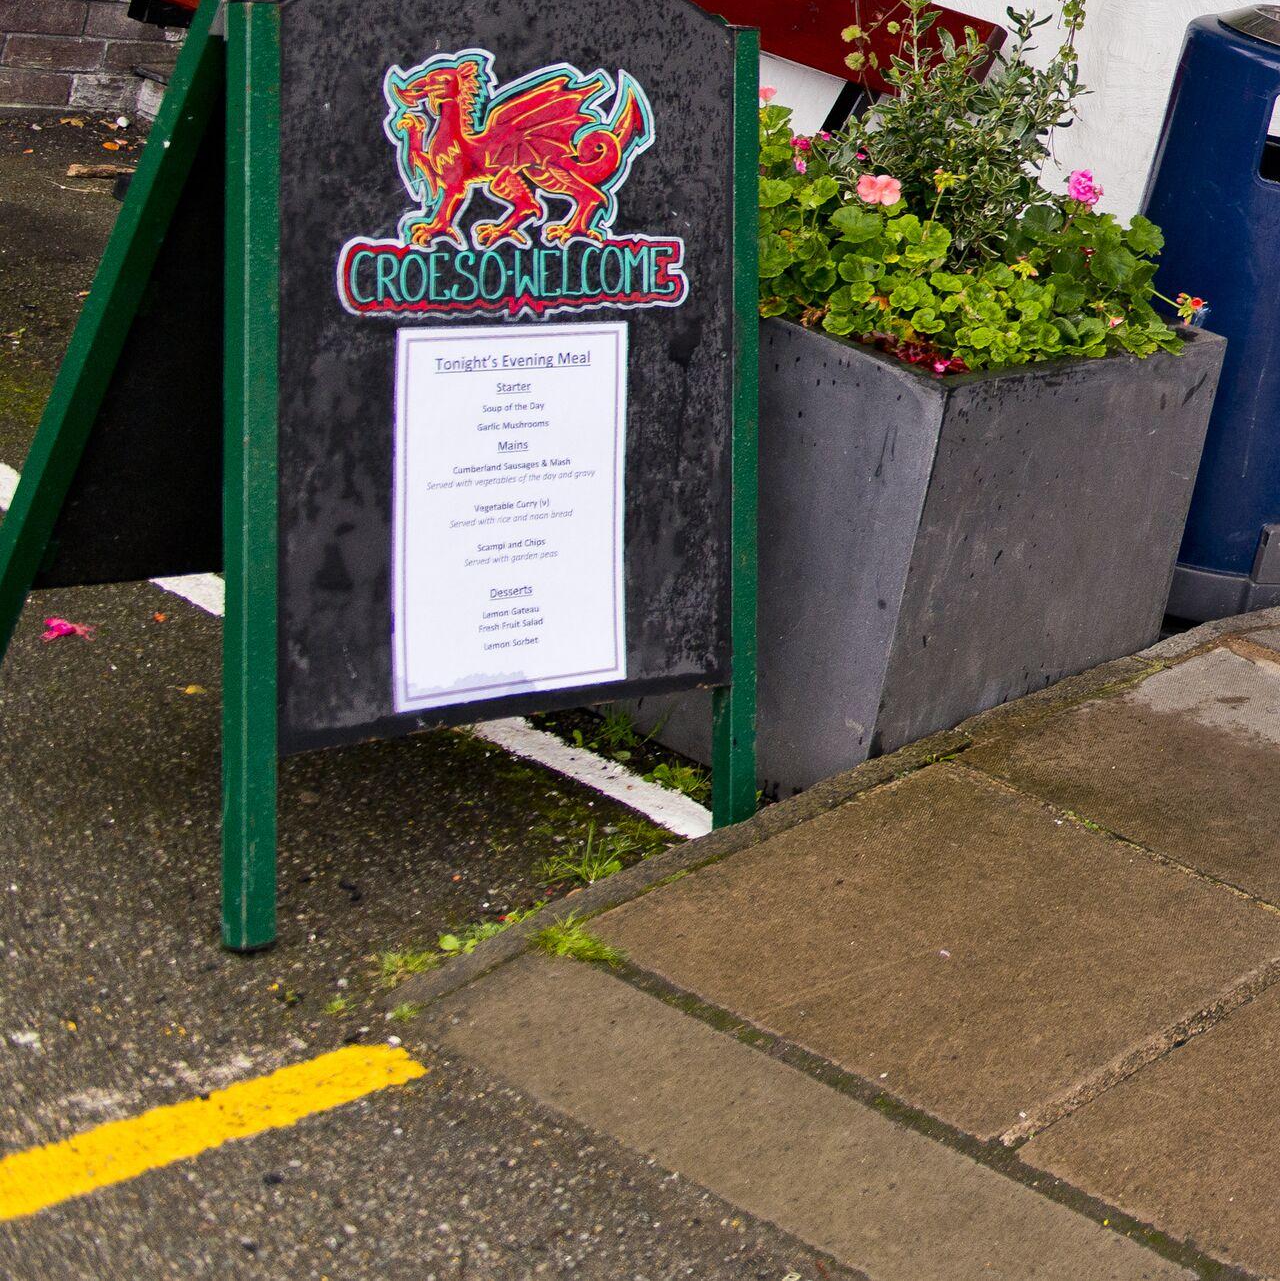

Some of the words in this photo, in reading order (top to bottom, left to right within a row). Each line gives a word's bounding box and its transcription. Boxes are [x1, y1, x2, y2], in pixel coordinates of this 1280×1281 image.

[435, 355, 498, 372] Tonight's
[502, 353, 554, 368] Evening
[558, 350, 591, 365] Meal
[496, 382, 532, 393] Starter
[482, 404, 502, 415] Soup
[504, 403, 513, 412] of
[514, 402, 528, 411] the
[530, 401, 545, 412] Day
[477, 422, 500, 432] Garlic
[502, 419, 550, 431] Mushrooms
[497, 440, 529, 452] Mains
[453, 462, 502, 475] Cumberland
[503, 460, 540, 472] Sausages
[550, 457, 571, 467] Mash
[426, 480, 454, 491] Served
[455, 478, 473, 488] with
[475, 474, 517, 488] vegetables
[518, 474, 528, 484] of
[529, 472, 541, 482] the
[542, 471, 557, 482] day
[558, 470, 573, 479] and
[573, 469, 596, 480] gravy
[474, 501, 514, 514] Vegetable
[516, 499, 538, 510] Curry
[539, 498, 550, 509] (v)
[449, 519, 476, 529] Served
[477, 516, 495, 525] with
[497, 514, 510, 523] rice
[512, 513, 528, 522] and
[529, 512, 549, 521] naan
[550, 509, 574, 519] bread
[477, 542, 506, 553] Scampi
[507, 540, 522, 549] and
[524, 538, 546, 549] Chips
[464, 557, 491, 568] Served
[492, 555, 509, 564] with
[510, 551, 538, 564] garden
[539, 550, 559, 561] peas
[490, 584, 533, 599] Desserts
[482, 609, 509, 620] Lemon
[511, 605, 540, 616] Gateau
[478, 623, 500, 633] Fresh
[501, 620, 520, 630] Fruit
[522, 617, 544, 628] Salad
[484, 640, 510, 651] Lemon
[512, 635, 539, 647] Sorbet
